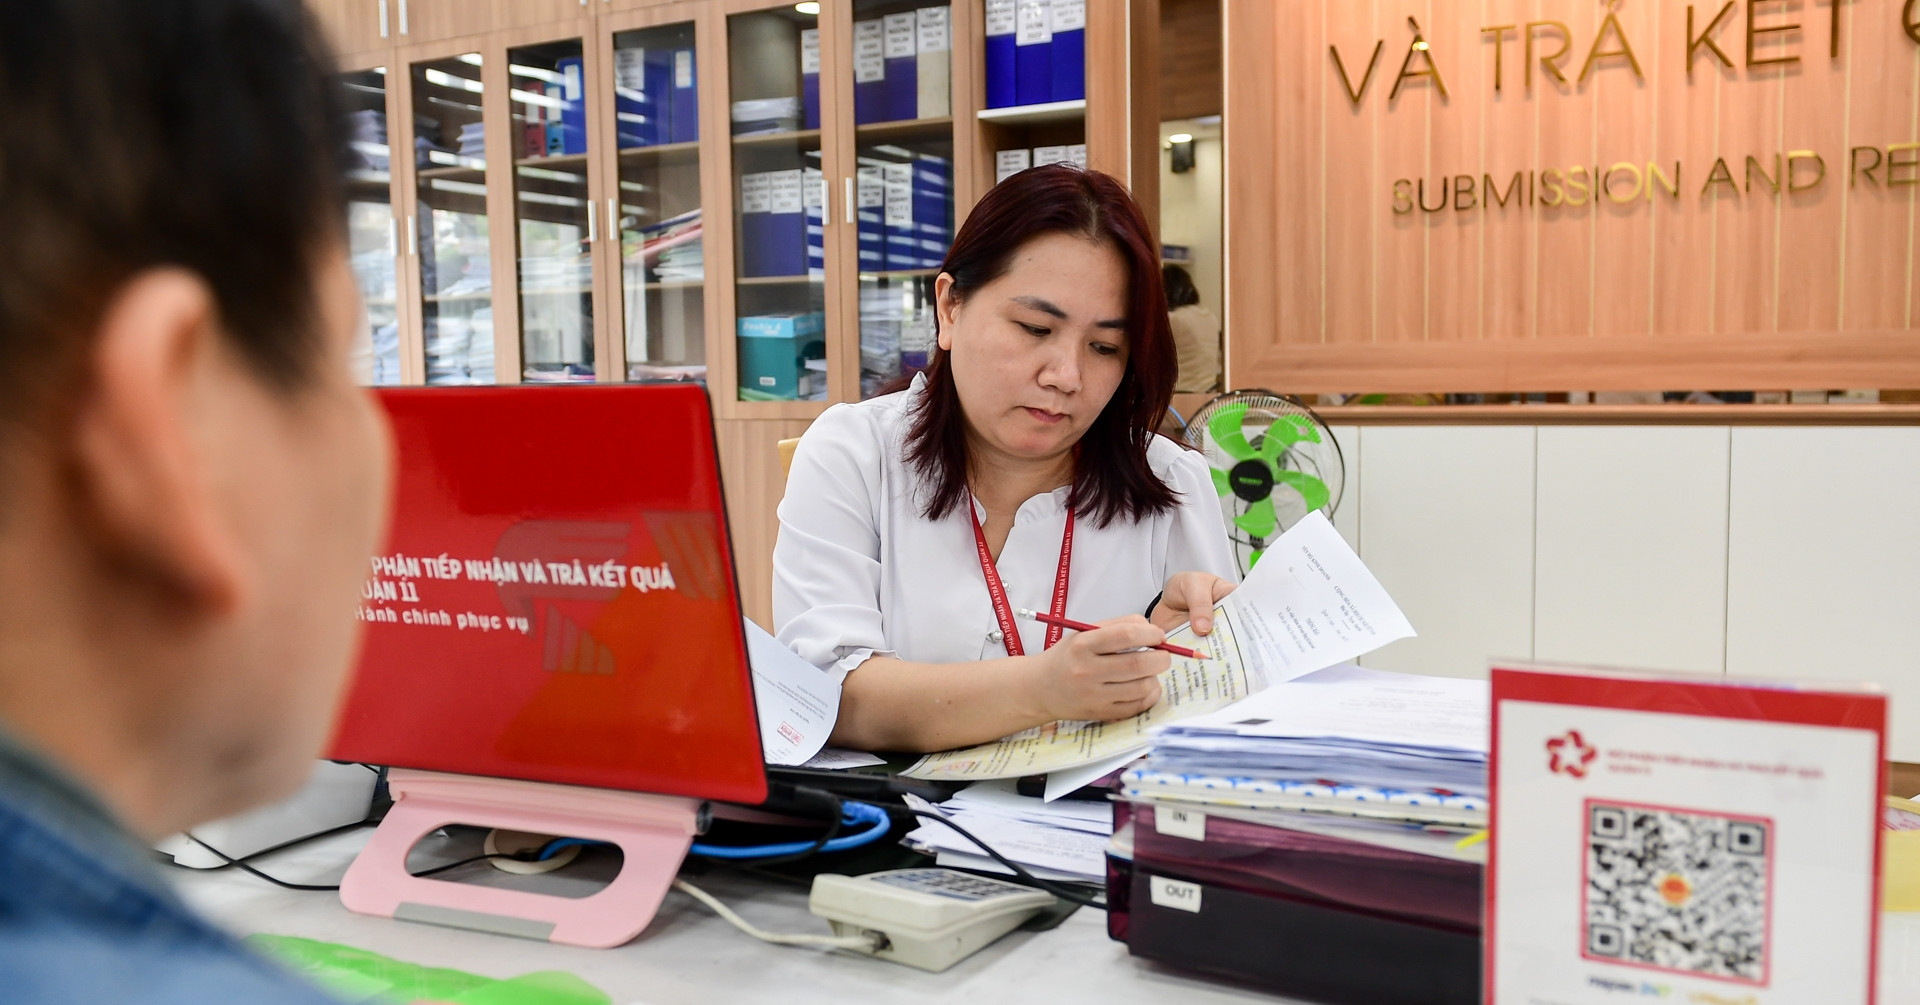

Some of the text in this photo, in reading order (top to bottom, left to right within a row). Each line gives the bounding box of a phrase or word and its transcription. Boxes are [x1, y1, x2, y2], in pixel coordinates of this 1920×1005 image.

[1330, 16, 1447, 103] VÀ
[1392, 160, 1680, 215] SUBMISSION
[1702, 150, 1826, 196] AND
[421, 552, 462, 580] TIẾP
[464, 557, 519, 587] NHẬN
[519, 558, 548, 584] VÀ
[546, 558, 587, 587] TRẢ
[587, 559, 627, 588] KẾT
[630, 562, 676, 593] QUẢ
[358, 577, 420, 604] UẬN 11
[402, 608, 452, 626] chính
[456, 611, 501, 632] phục
[506, 616, 529, 635] vụ
[1165, 884, 1194, 899] OUT
